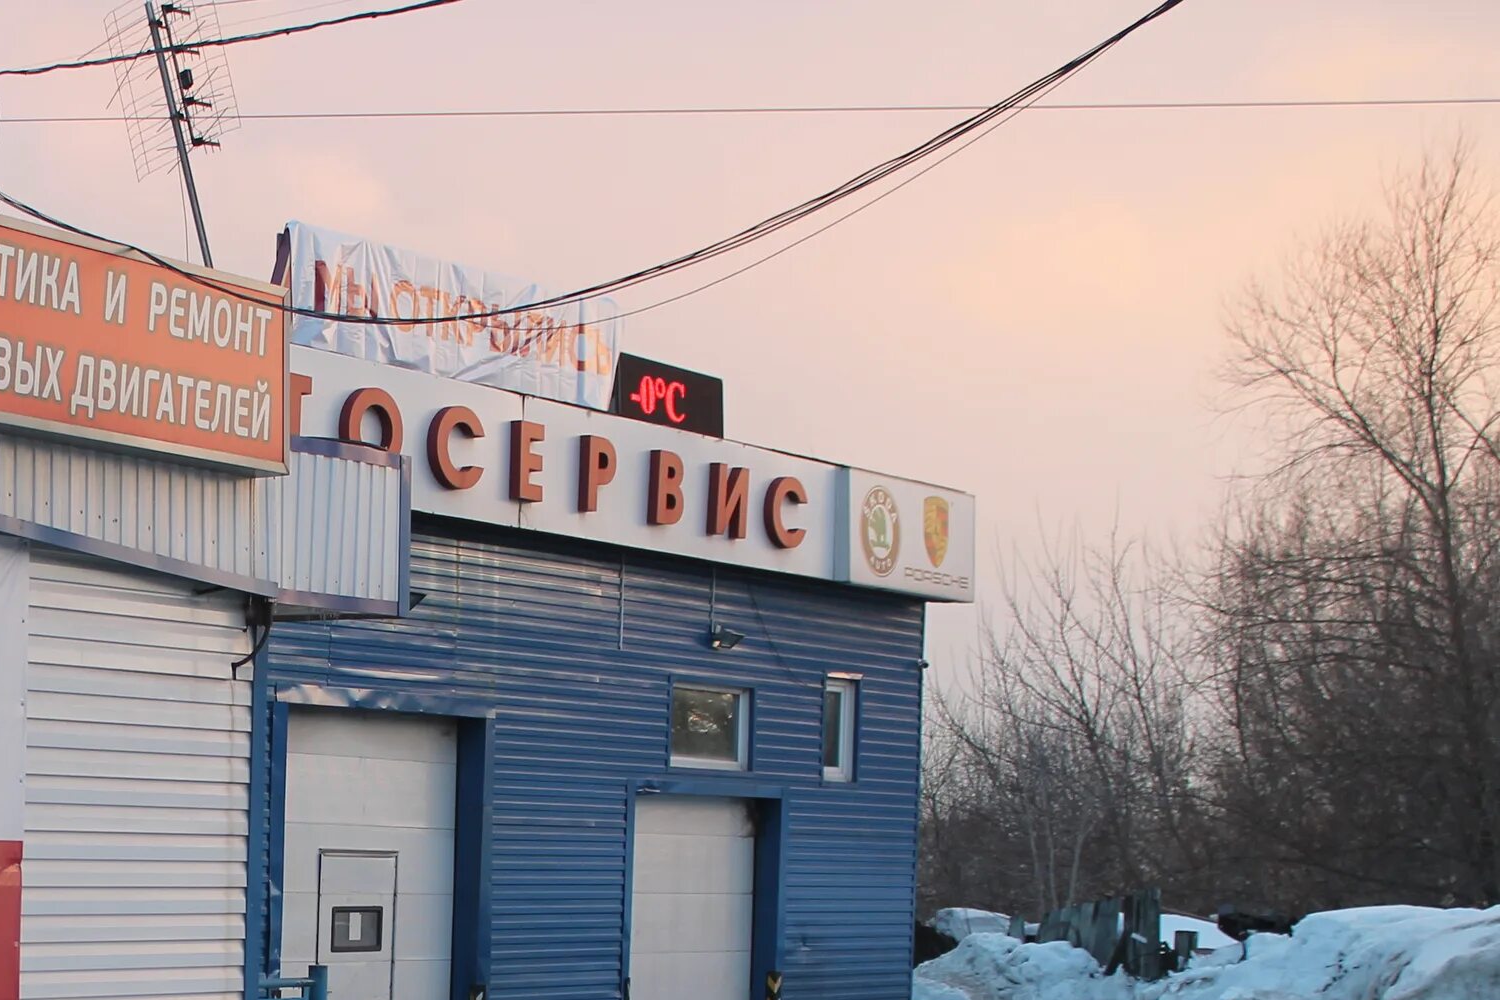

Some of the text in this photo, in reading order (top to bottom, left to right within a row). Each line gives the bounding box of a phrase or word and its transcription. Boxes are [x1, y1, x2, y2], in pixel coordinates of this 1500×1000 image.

[104, 271, 126, 324] И
[148, 283, 272, 356] РЕМОНТ
[314, 260, 378, 318] МЫ
[71, 355, 271, 441] ДВИГАТЕЛЕЙ
[904, 567, 969, 589] PORSCHE
